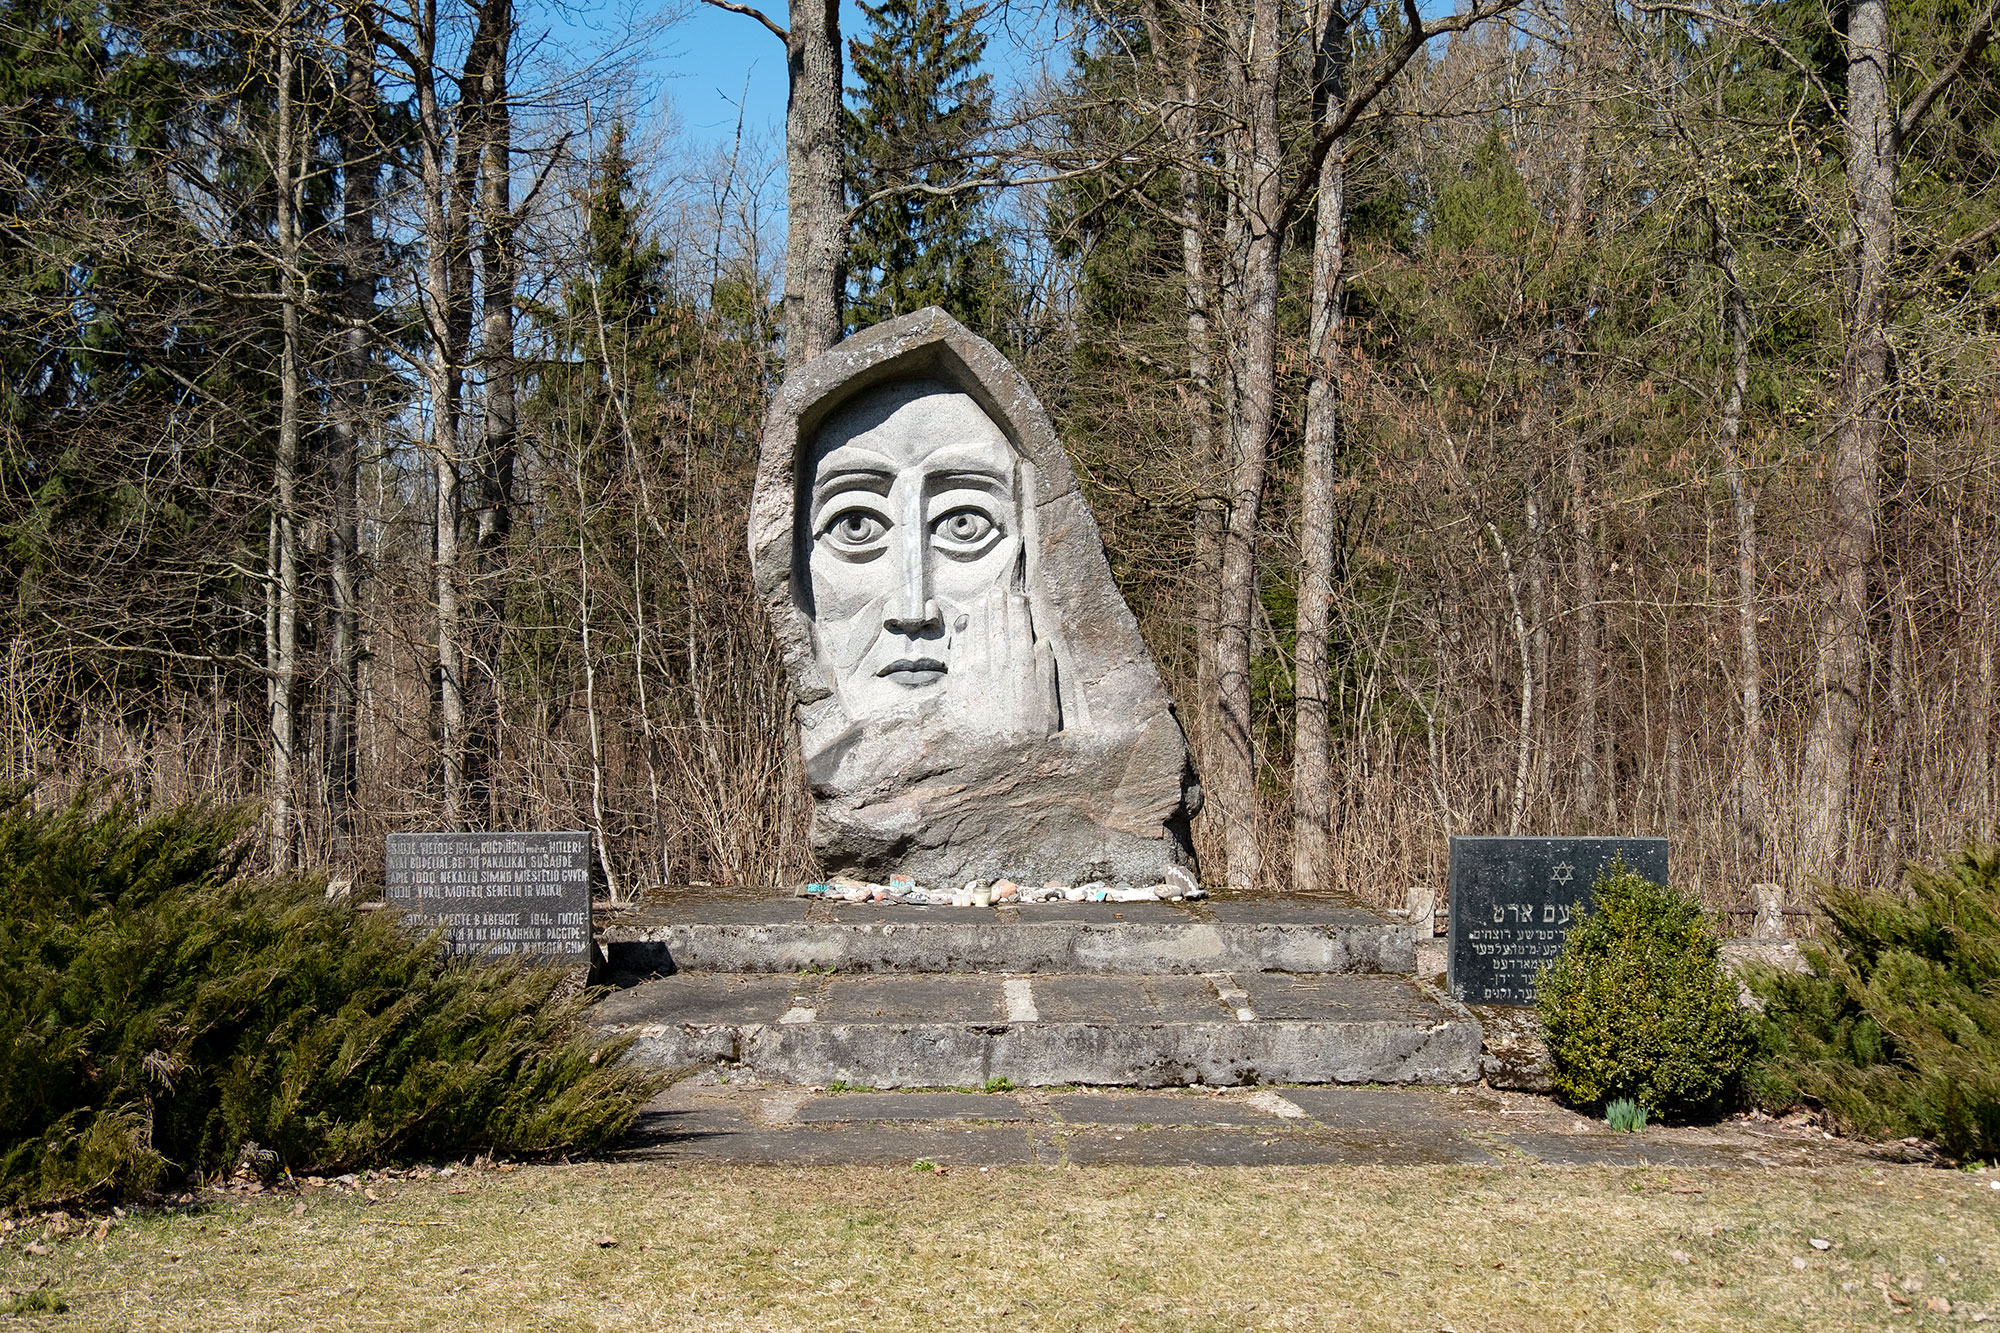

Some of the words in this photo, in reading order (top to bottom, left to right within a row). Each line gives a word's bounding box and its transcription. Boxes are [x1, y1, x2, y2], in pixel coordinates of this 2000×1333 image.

[482, 855, 526, 869] PAKALIKAI
[481, 870, 511, 883] SIMNO
[525, 885, 533, 896] IR
[482, 913, 520, 926] АВГУСТЕ
[1493, 904, 1533, 923] ארט
[1543, 904, 1570, 924] עם
